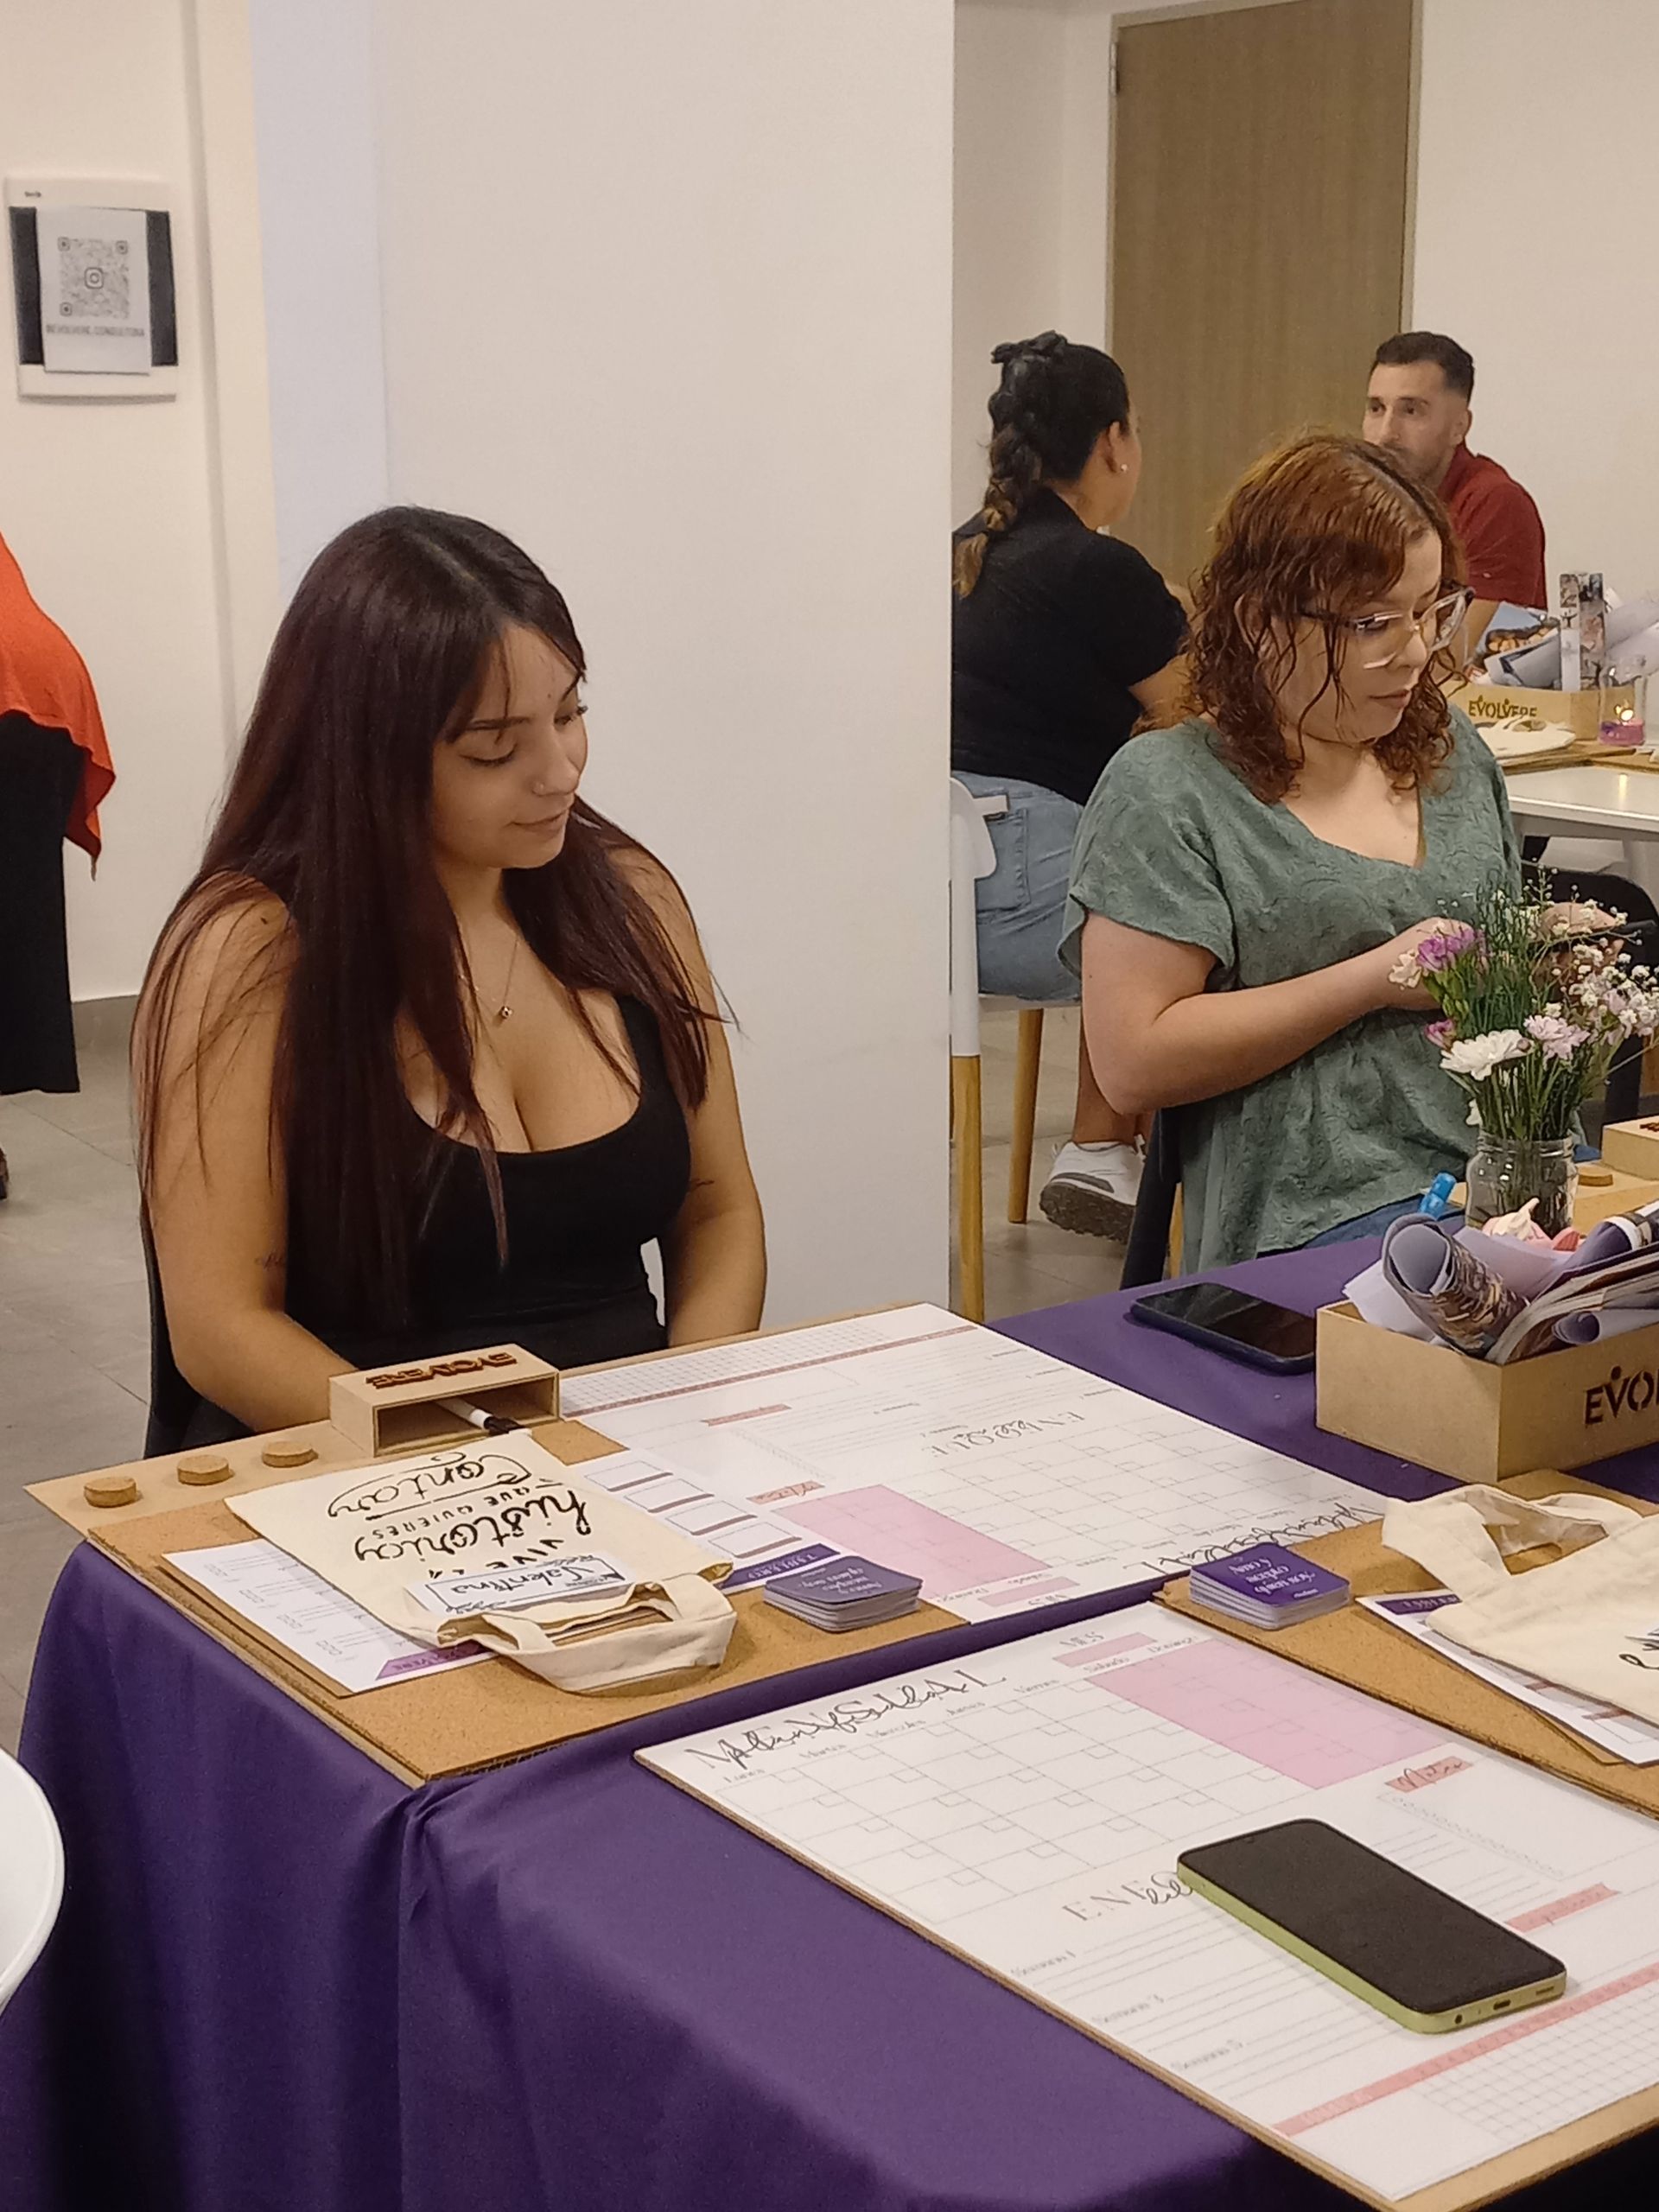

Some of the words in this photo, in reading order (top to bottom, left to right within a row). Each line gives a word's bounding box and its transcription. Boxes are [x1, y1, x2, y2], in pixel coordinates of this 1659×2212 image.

[365, 1351, 518, 1389] EVOLVERE
[1585, 1365, 1659, 1427] EVO
[483, 1485, 531, 1508] QUE
[371, 1504, 474, 1539] QUIERES
[485, 1538, 564, 1569] VIVE
[450, 1565, 595, 1595] Valentina
